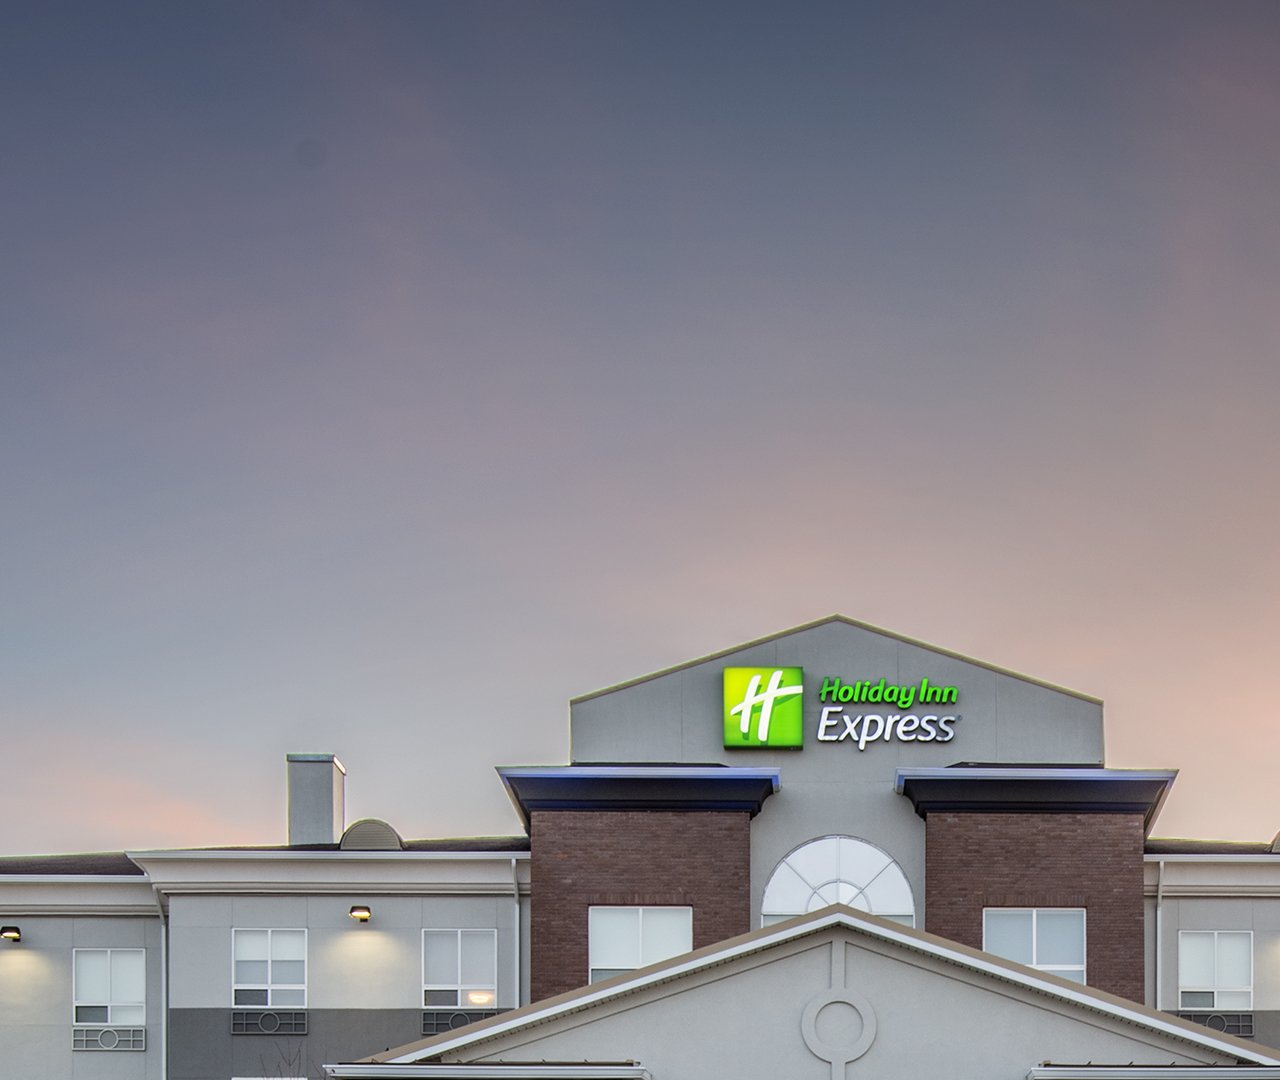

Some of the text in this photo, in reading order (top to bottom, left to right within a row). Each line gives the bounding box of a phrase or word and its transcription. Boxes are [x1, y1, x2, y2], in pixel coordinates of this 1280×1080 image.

[820, 677, 959, 709] Holiday Inn
[817, 706, 956, 751] Express
